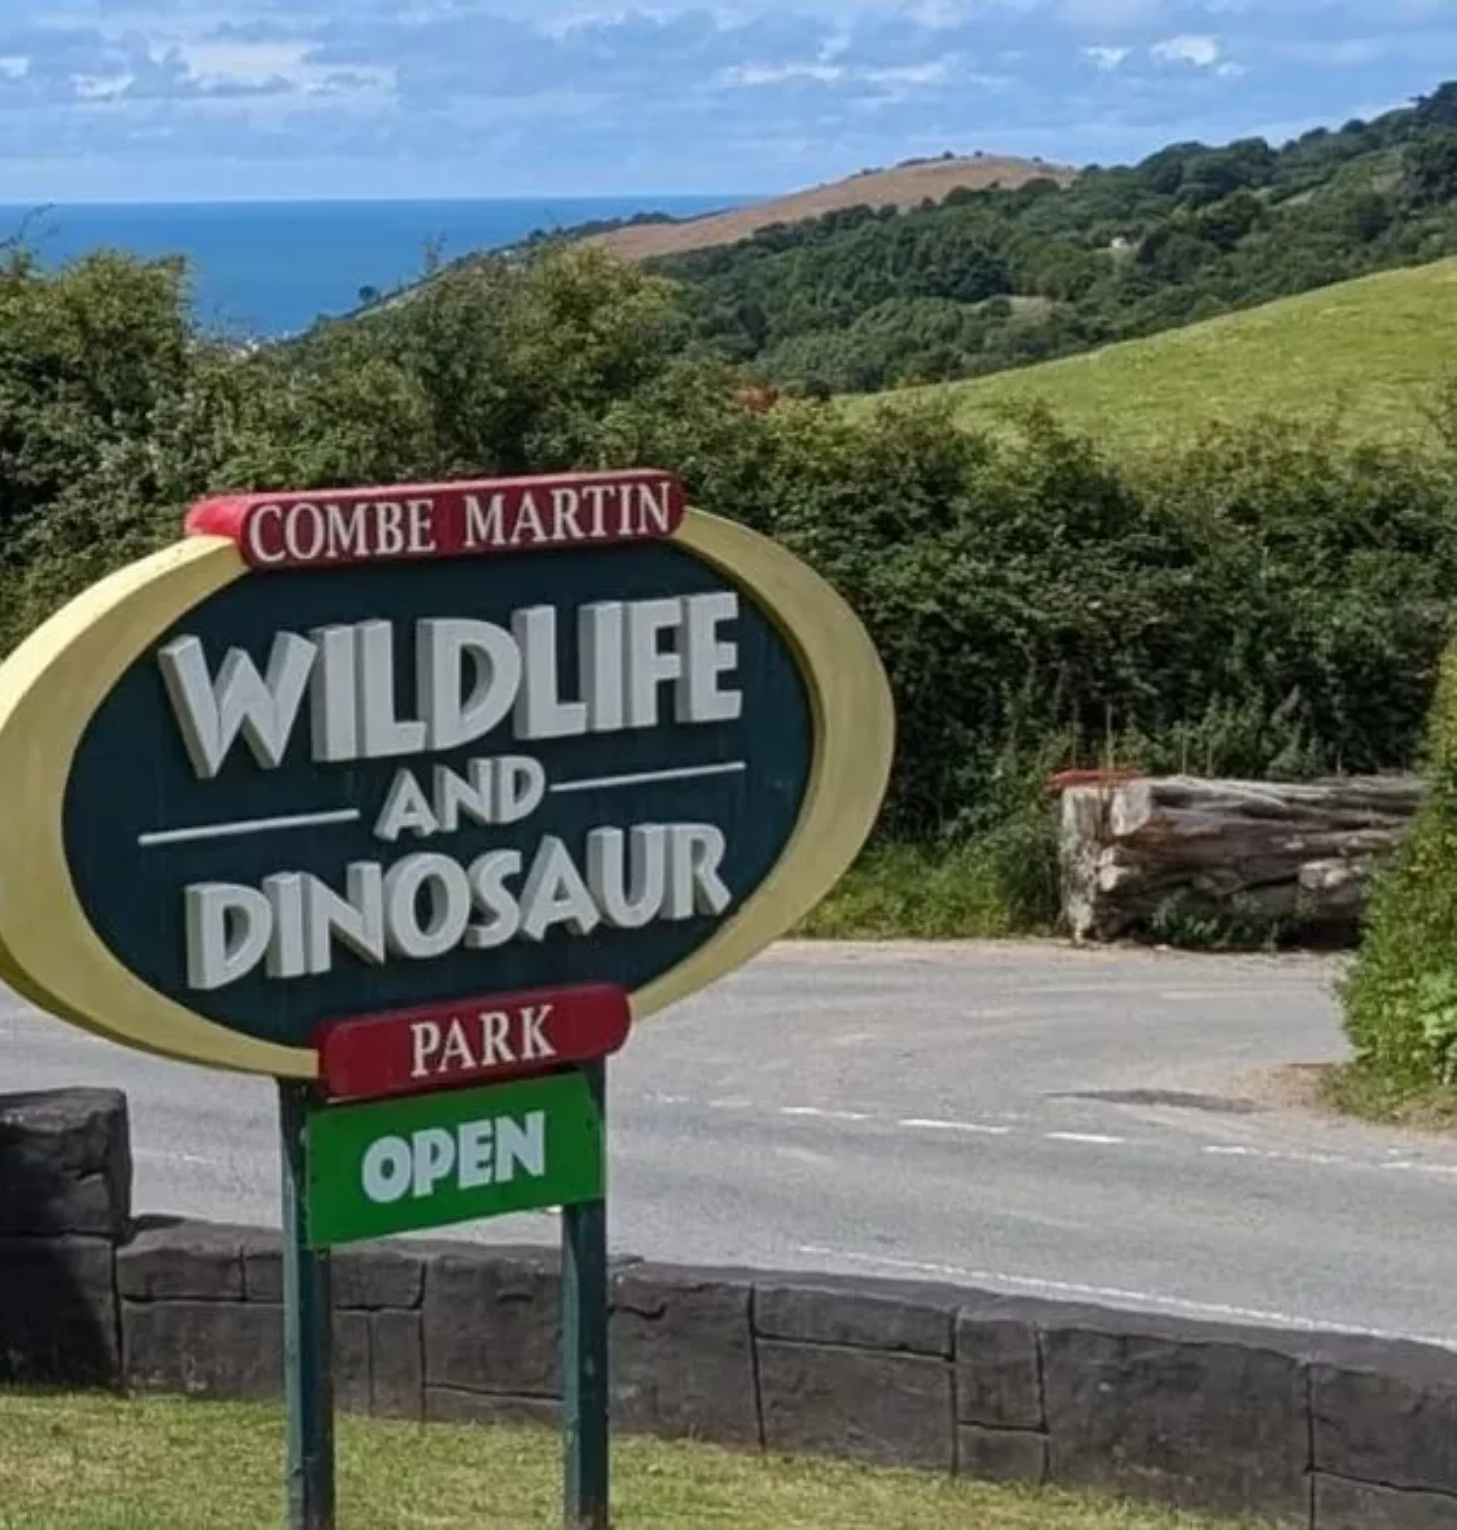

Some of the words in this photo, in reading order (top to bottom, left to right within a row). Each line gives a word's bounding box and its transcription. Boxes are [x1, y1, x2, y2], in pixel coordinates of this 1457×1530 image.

[247, 498, 437, 563] COMBE
[464, 481, 672, 548] MARTIN
[158, 592, 743, 778] WILDLIFE
[375, 755, 546, 842] AND
[184, 822, 732, 989] DINOSAUR
[409, 1005, 556, 1077] PARK
[361, 1109, 546, 1202] OPEN
